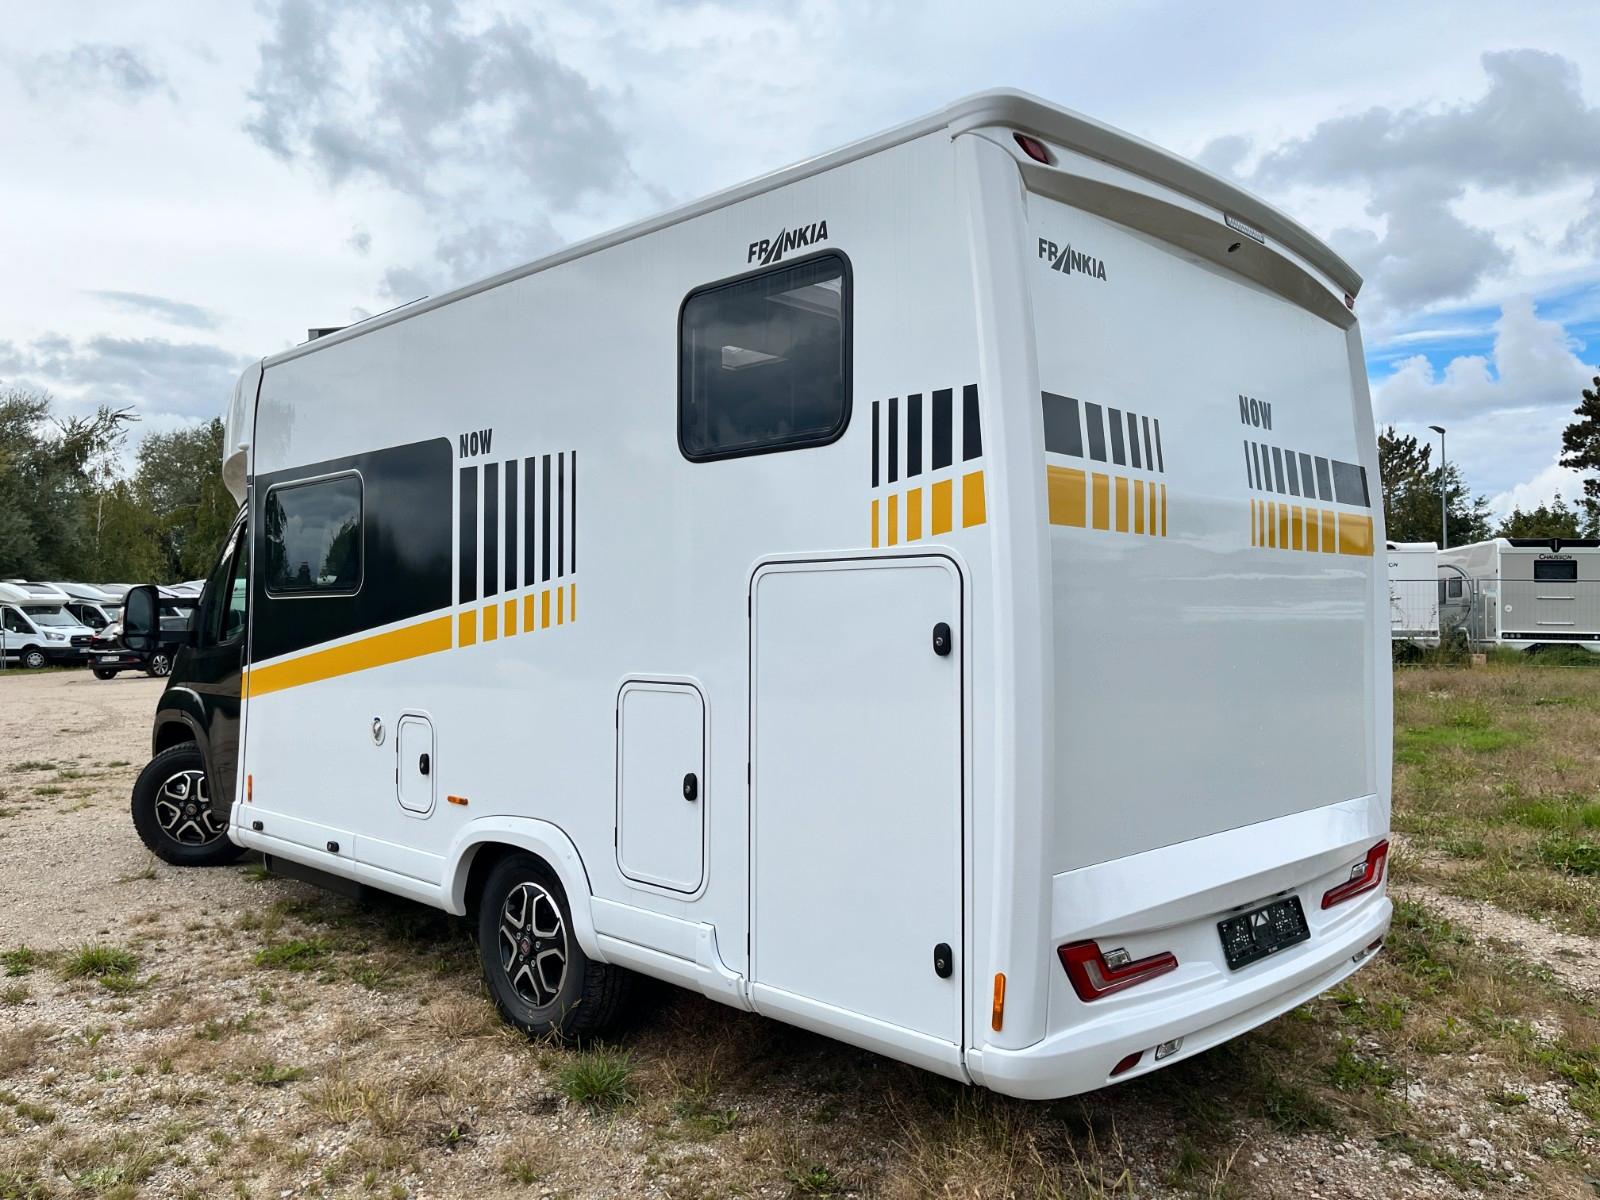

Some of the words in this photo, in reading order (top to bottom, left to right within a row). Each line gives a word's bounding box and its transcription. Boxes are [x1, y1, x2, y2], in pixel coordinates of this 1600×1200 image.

[747, 219, 828, 266] FRANKIA
[1038, 236, 1107, 281] FRANKIA
[1238, 394, 1272, 431] NOW
[459, 427, 493, 459] NOW
